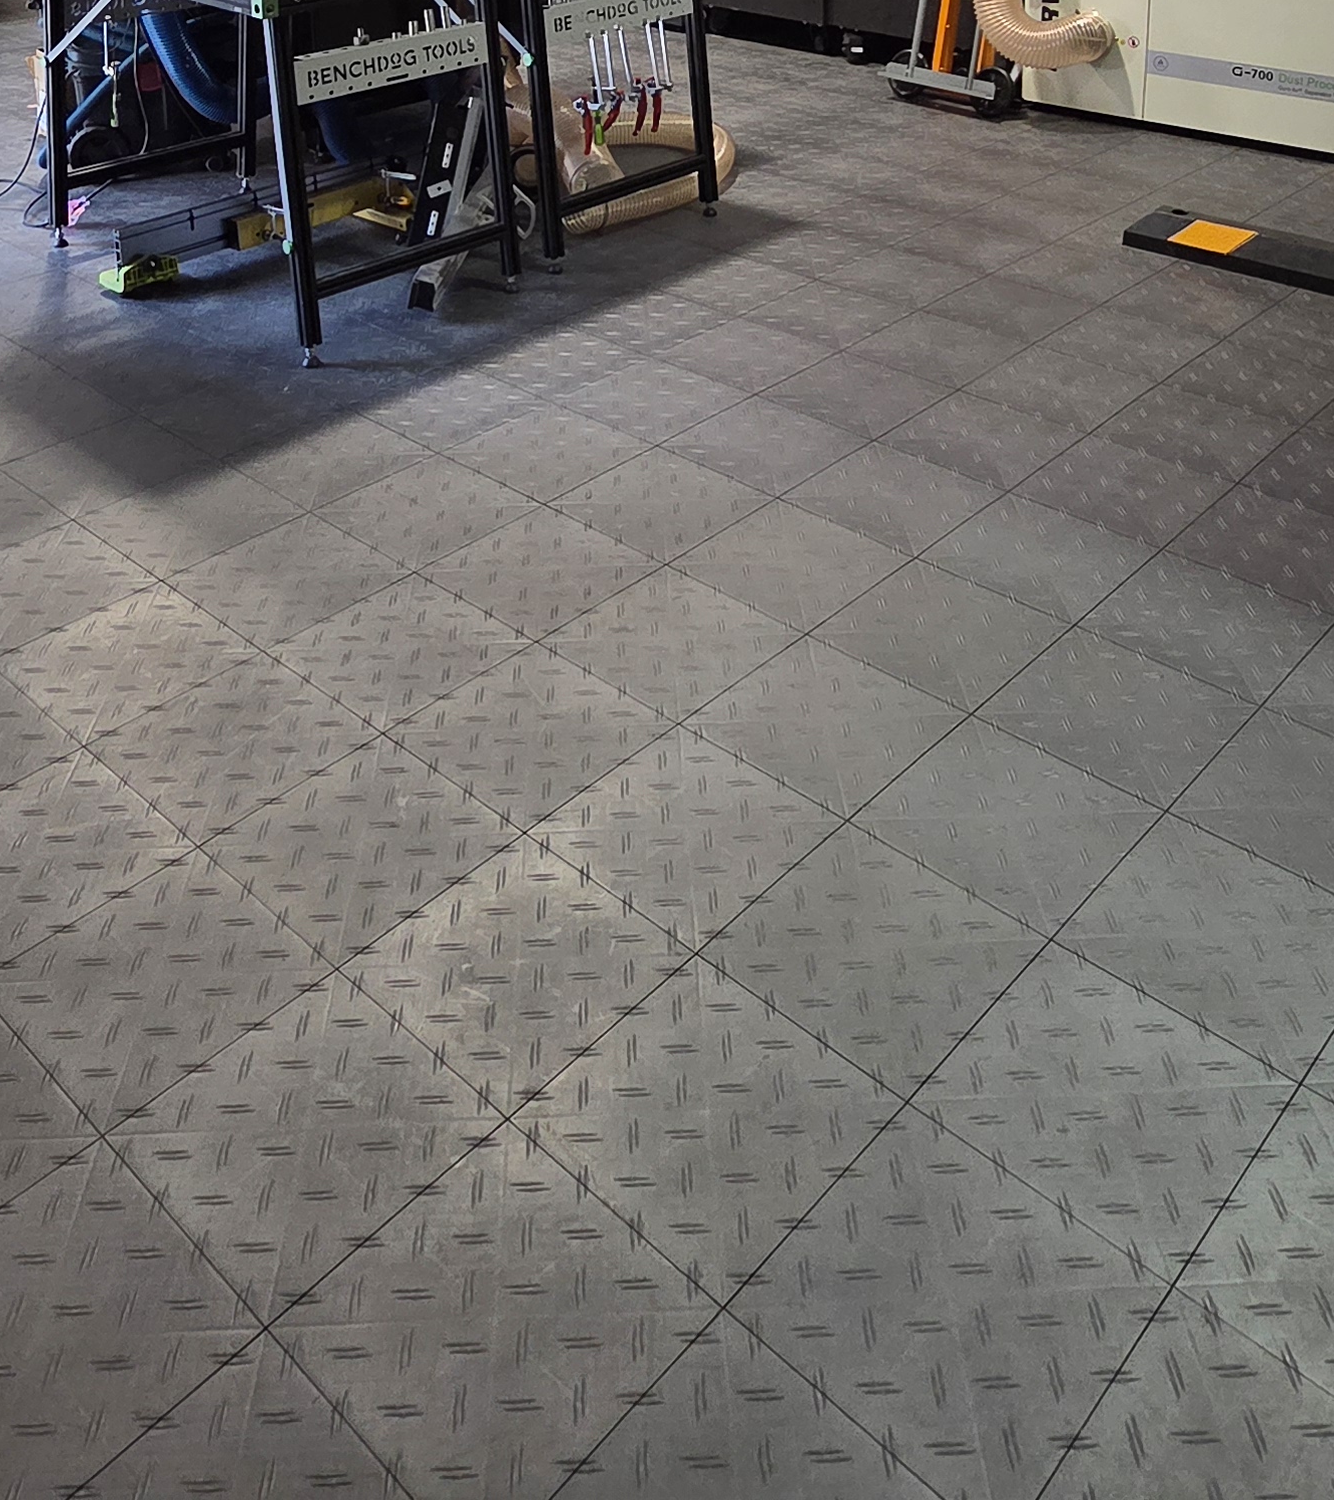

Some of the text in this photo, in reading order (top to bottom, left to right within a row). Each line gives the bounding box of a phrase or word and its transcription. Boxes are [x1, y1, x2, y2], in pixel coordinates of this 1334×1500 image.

[553, 0, 639, 33] BECHDOG
[307, 37, 476, 88] BENCHDOG TOOLS
[1278, 72, 1304, 86] Dust
